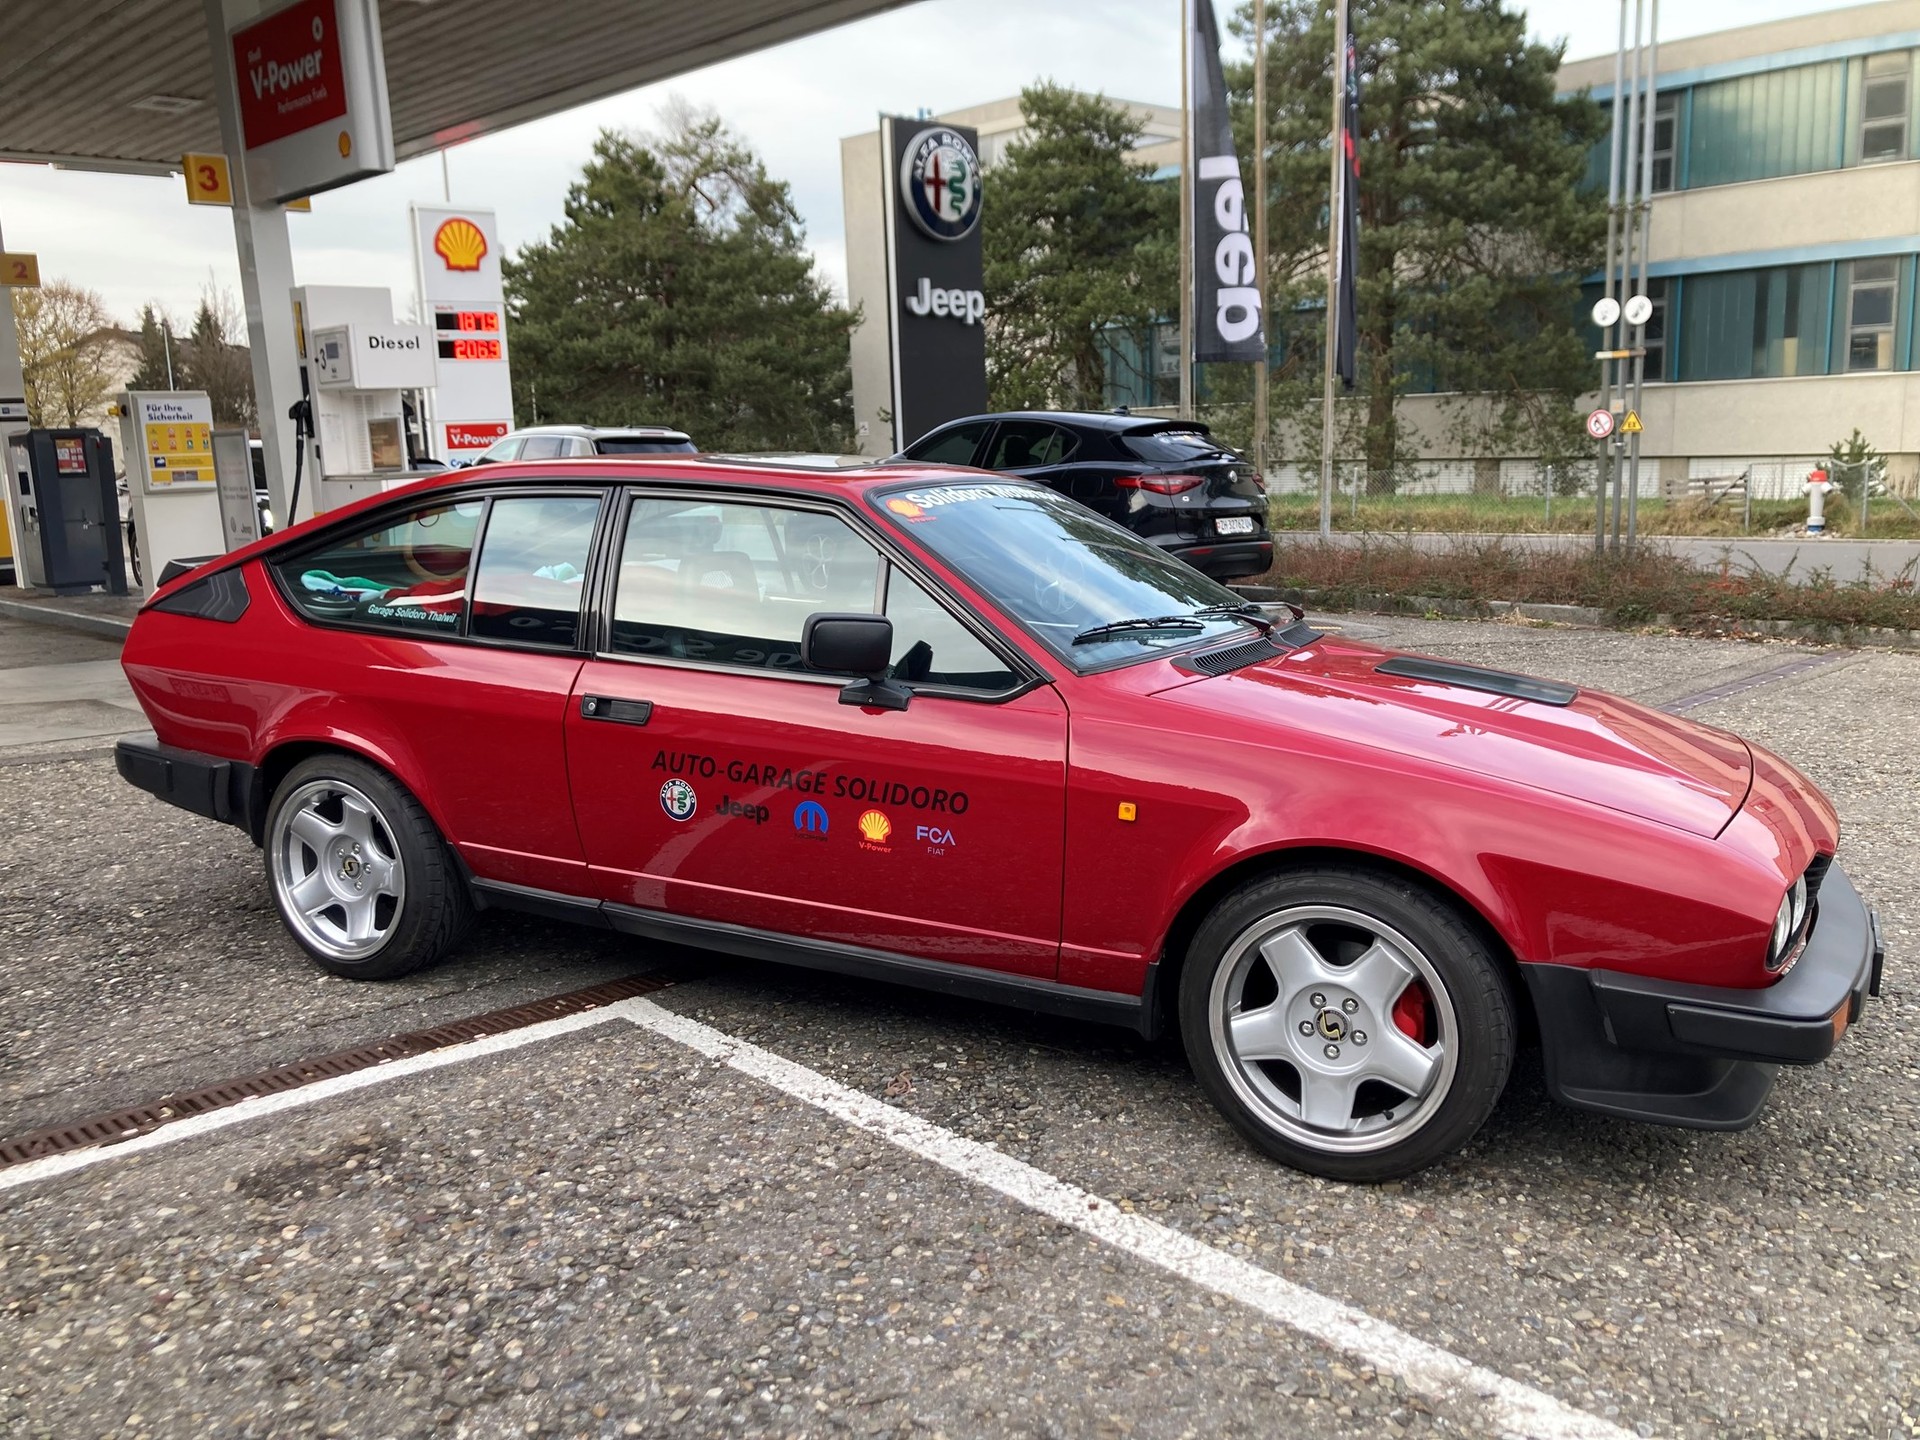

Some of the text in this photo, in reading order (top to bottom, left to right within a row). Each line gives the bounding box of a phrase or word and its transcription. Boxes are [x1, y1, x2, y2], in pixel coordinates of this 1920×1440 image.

[249, 48, 323, 100] V-Power
[914, 136, 939, 180] ALFA
[198, 164, 219, 192] 3
[12, 262, 27, 279] 2
[906, 277, 986, 326] Jeep
[368, 335, 420, 350] Diesel
[319, 348, 327, 370] 3
[146, 403, 183, 412] Für Ihre
[147, 412, 194, 421] Sicherheit
[450, 433, 499, 446] V-Powe
[905, 486, 993, 509] Solidoro
[367, 603, 457, 623] Garage Solidoro Thalwil
[650, 750, 969, 815] AUTO-GARAGE SOLIDORO
[661, 780, 695, 804] ALFA ROMEO
[715, 795, 770, 825] Jeep
[916, 825, 956, 846] FCA
[858, 841, 892, 853] V-Power
[927, 846, 946, 856] FIAT
